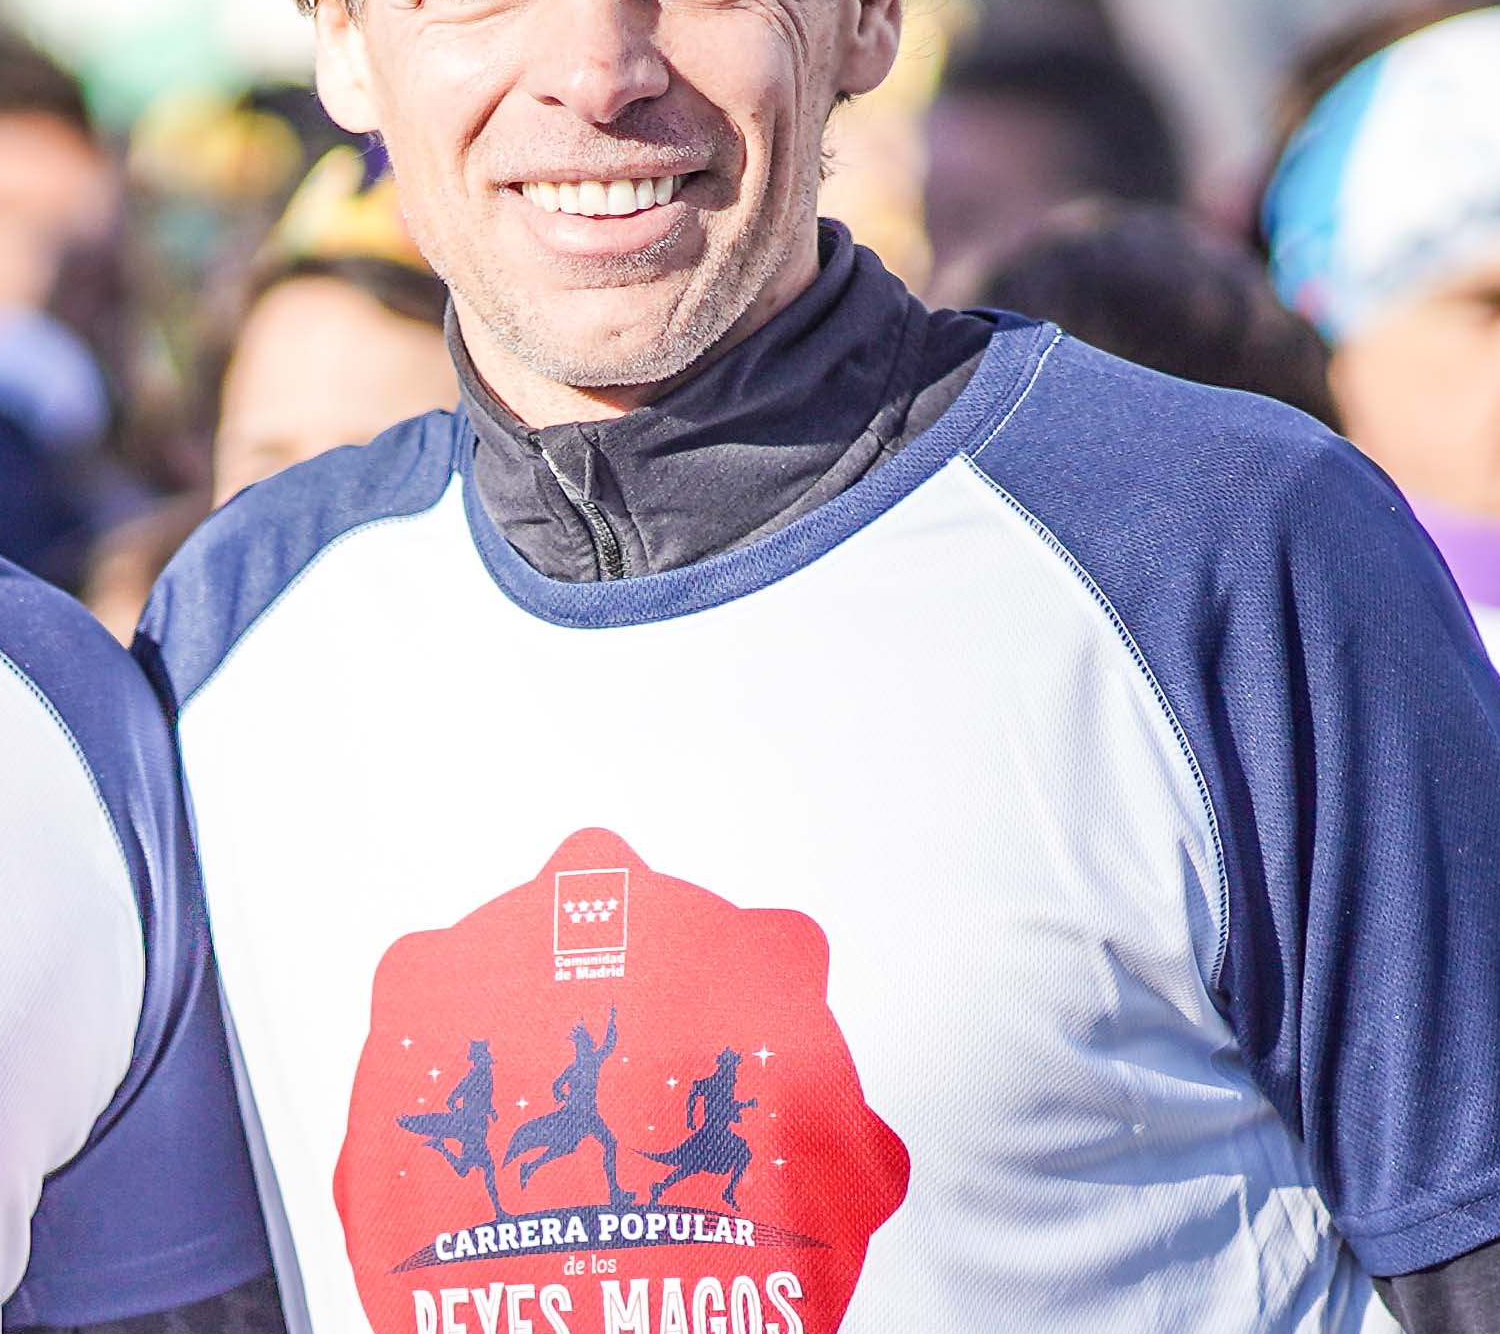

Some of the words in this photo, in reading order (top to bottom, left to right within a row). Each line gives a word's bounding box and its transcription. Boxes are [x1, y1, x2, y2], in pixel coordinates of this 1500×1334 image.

[555, 951, 626, 967] Comunidad
[555, 968, 572, 981] de
[575, 964, 625, 979] Madrid
[435, 1214, 589, 1262] CARRERA
[598, 1214, 756, 1247] POPULAR
[563, 1255, 585, 1275] de
[589, 1255, 617, 1274] los
